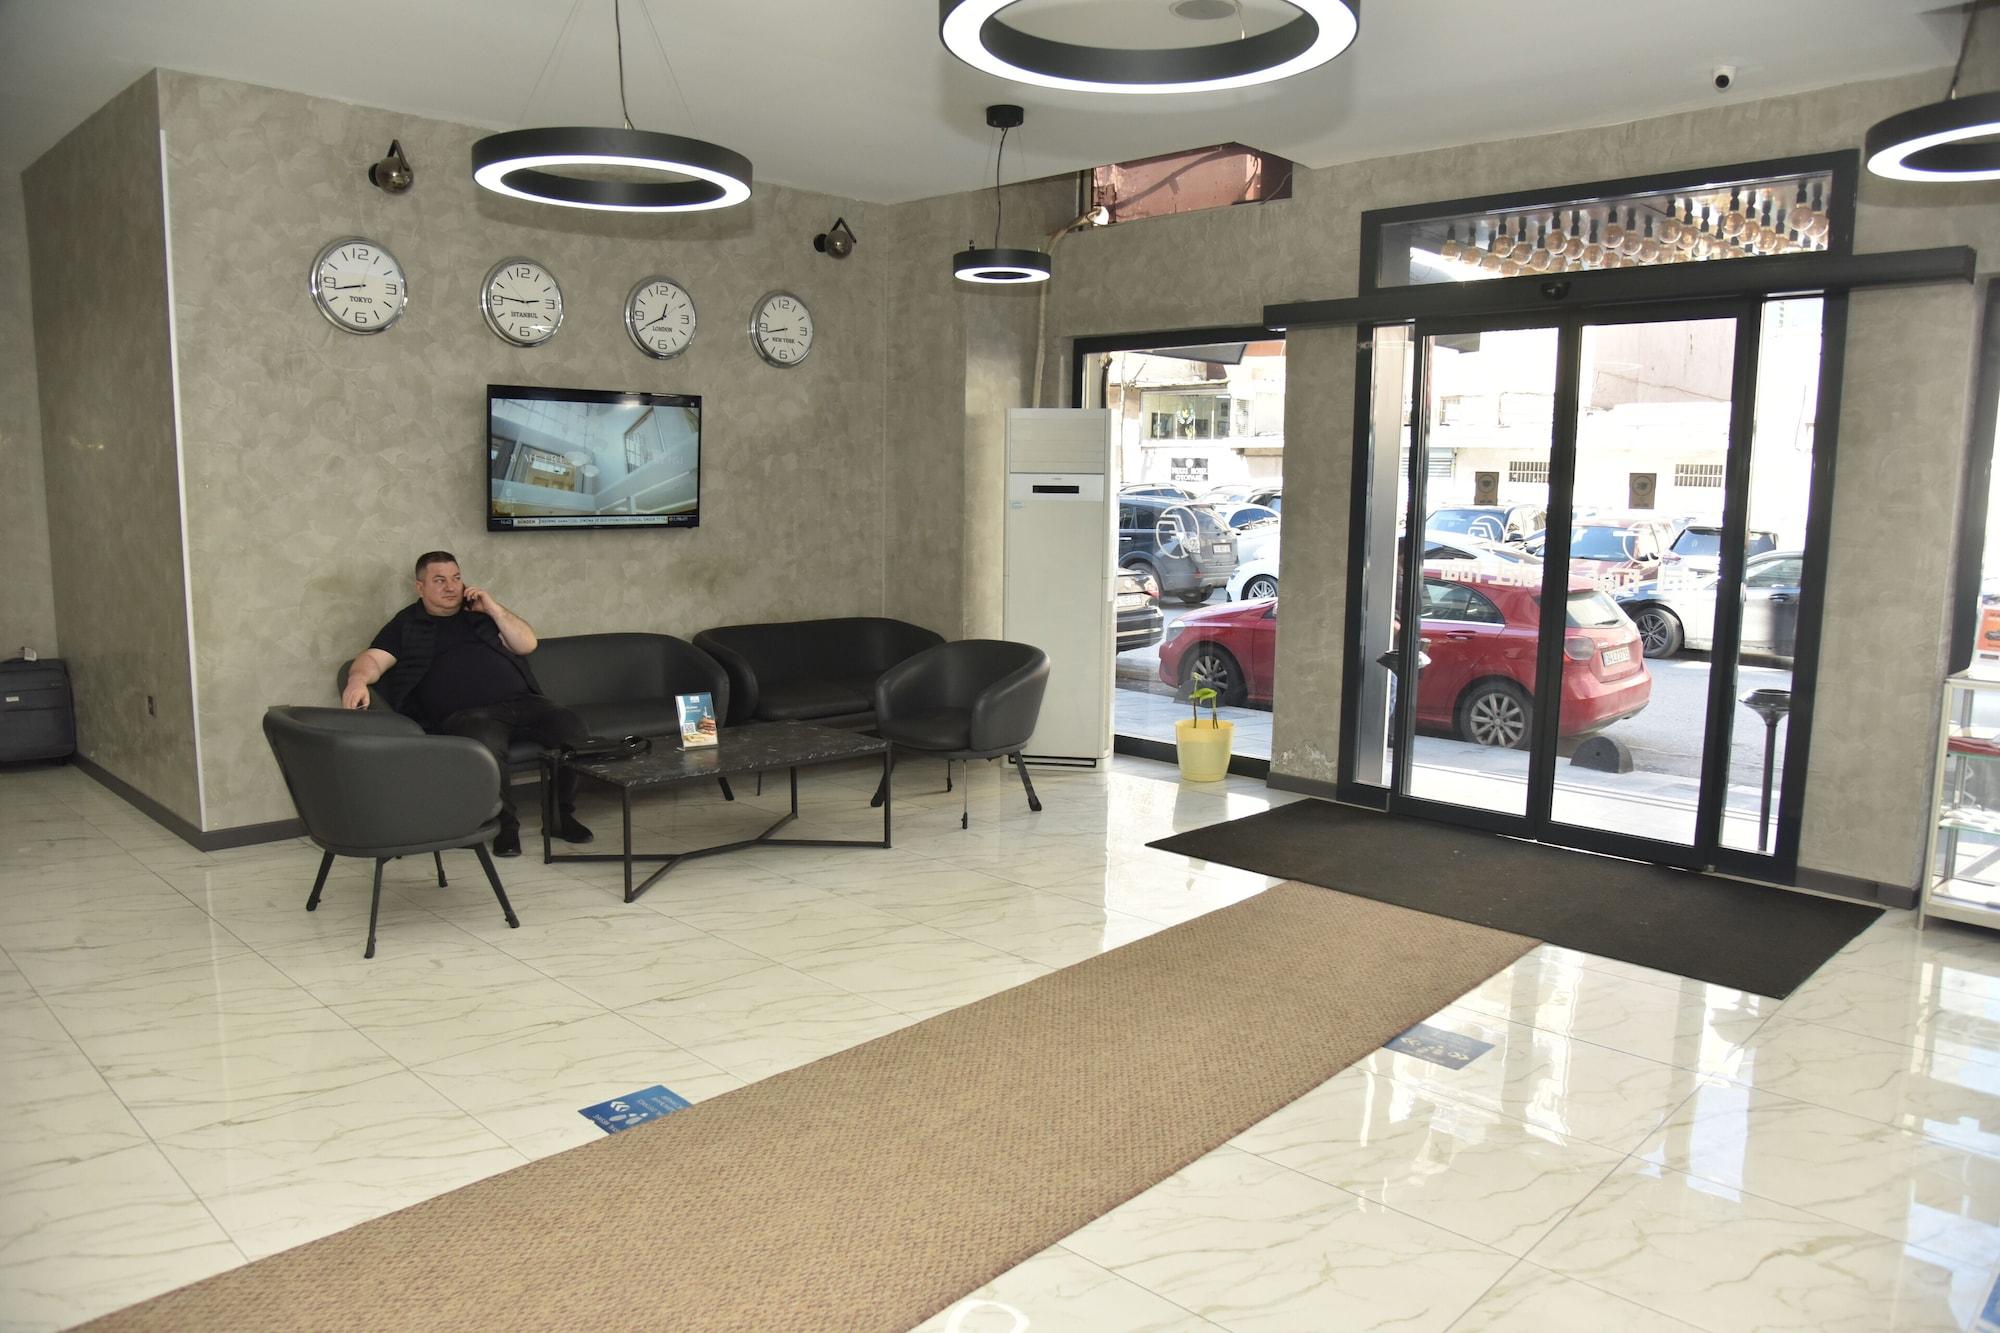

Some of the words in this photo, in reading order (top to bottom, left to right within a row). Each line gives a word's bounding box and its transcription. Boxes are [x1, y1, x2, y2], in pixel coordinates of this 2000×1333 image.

[352, 248, 369, 261] 12
[516, 267, 530, 279] 12
[323, 276, 337, 289] 9
[385, 283, 397, 295] 3
[656, 285, 669, 297] 12
[349, 295, 373, 304] TOKYO
[492, 295, 504, 306] 9
[545, 299, 555, 310] 3
[778, 299, 790, 310] 12
[355, 311, 367, 324] 6
[635, 310, 645, 321] 9
[680, 314, 690, 325] 3
[519, 326, 531, 337] 6
[652, 325, 673, 333] LONDON
[760, 322, 768, 332] 9
[799, 326, 808, 337] 3
[657, 339, 668, 350] 6
[779, 349, 788, 360] 6
